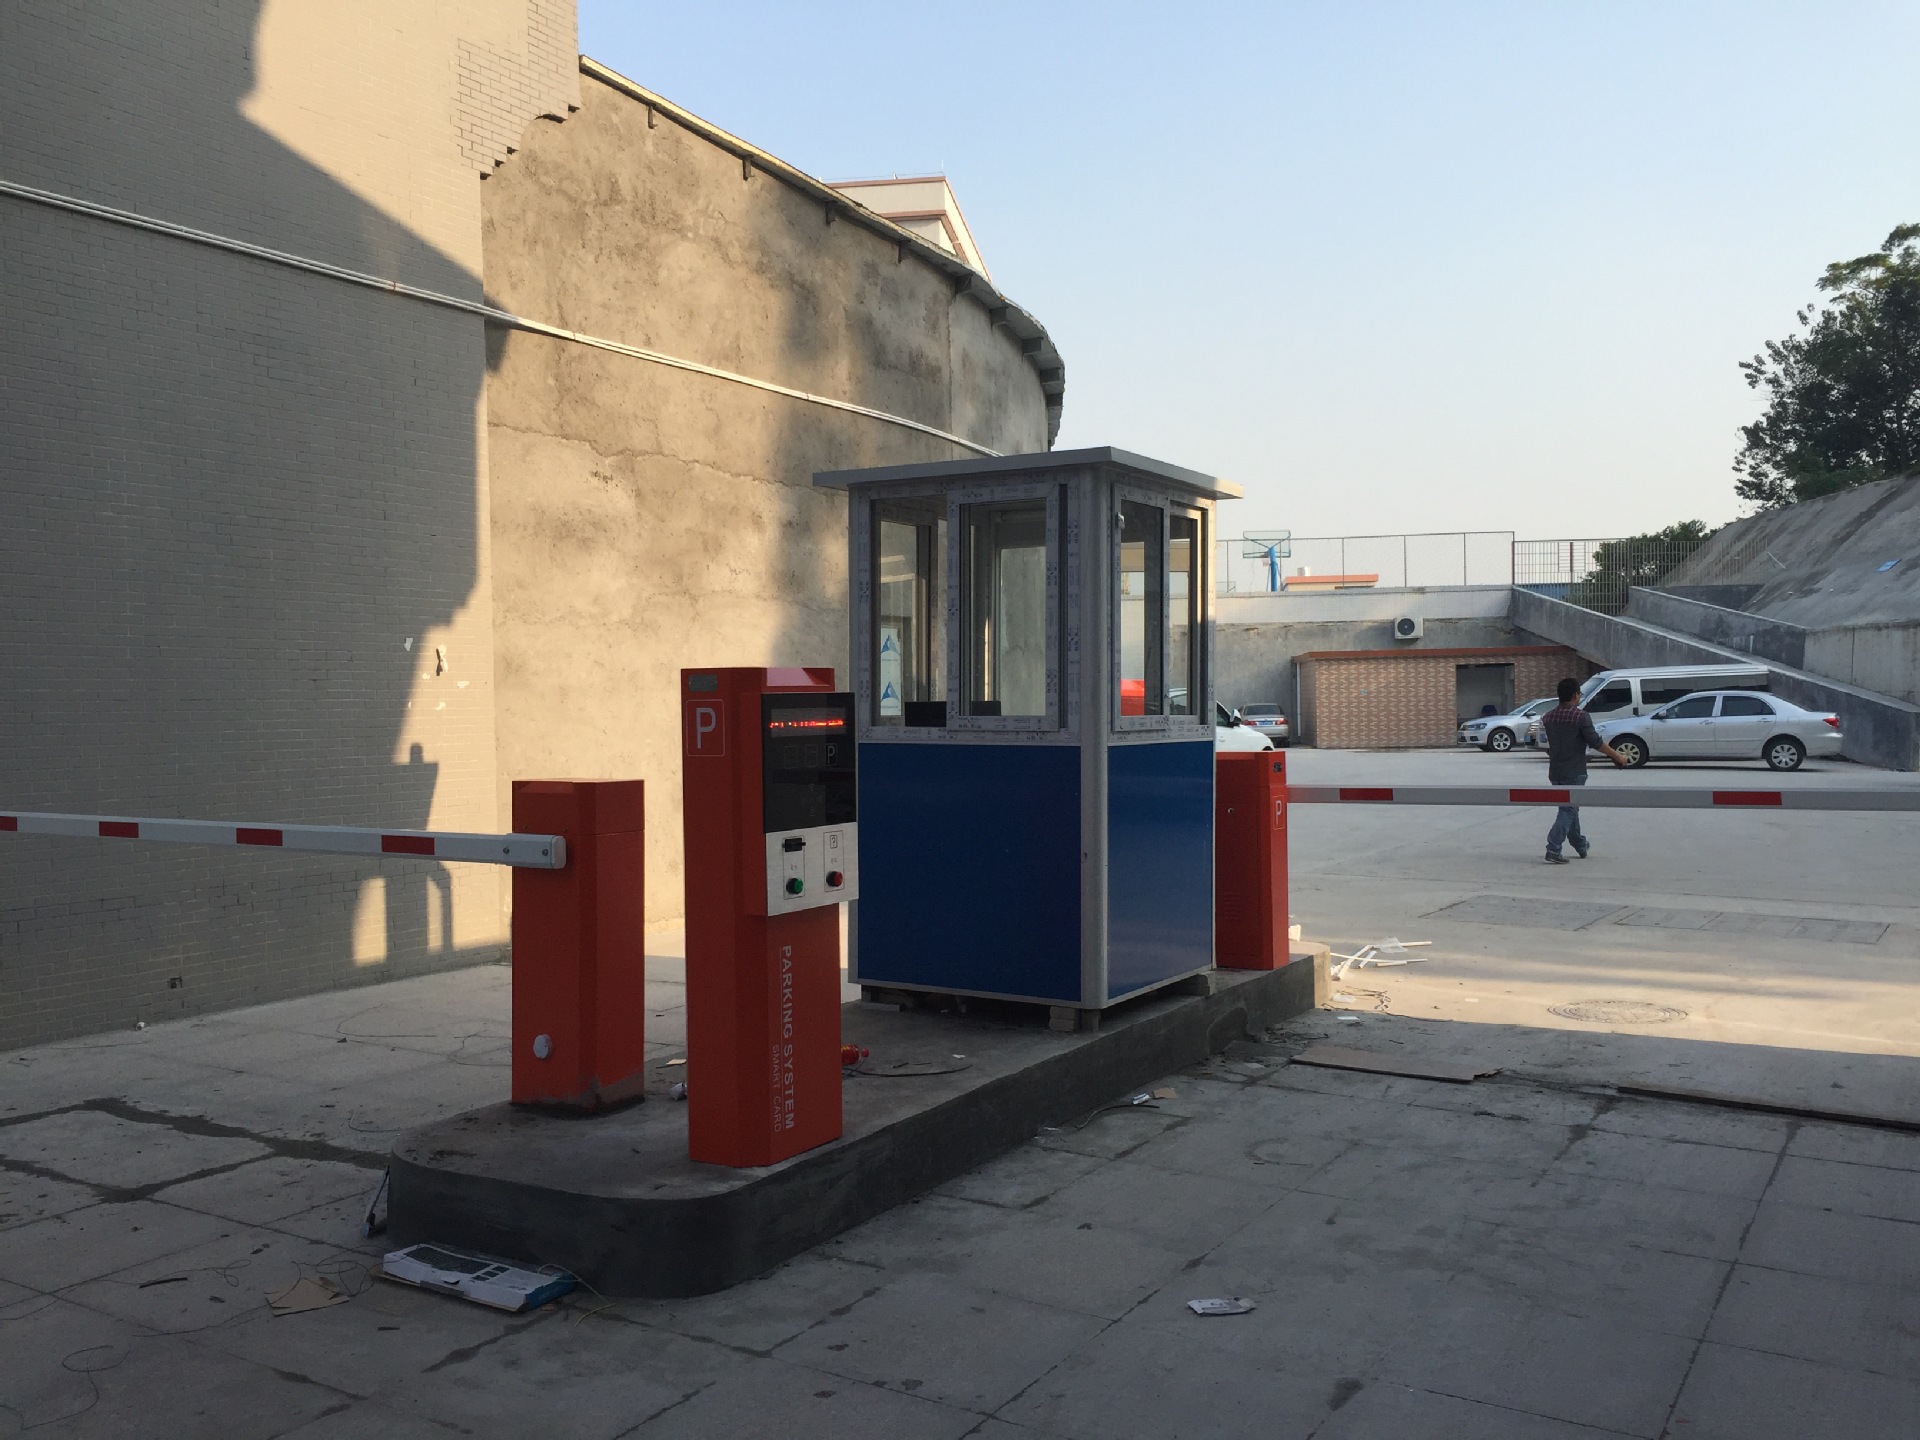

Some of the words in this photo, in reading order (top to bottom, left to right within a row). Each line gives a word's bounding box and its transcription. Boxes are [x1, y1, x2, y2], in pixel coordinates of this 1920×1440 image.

[695, 707, 716, 748] P
[828, 746, 835, 763] P
[1275, 800, 1282, 825] P
[782, 945, 792, 1039] PARKING
[772, 1044, 780, 1090] SMART
[784, 1044, 794, 1129] SYSTEM
[774, 1096, 782, 1132] CARD
